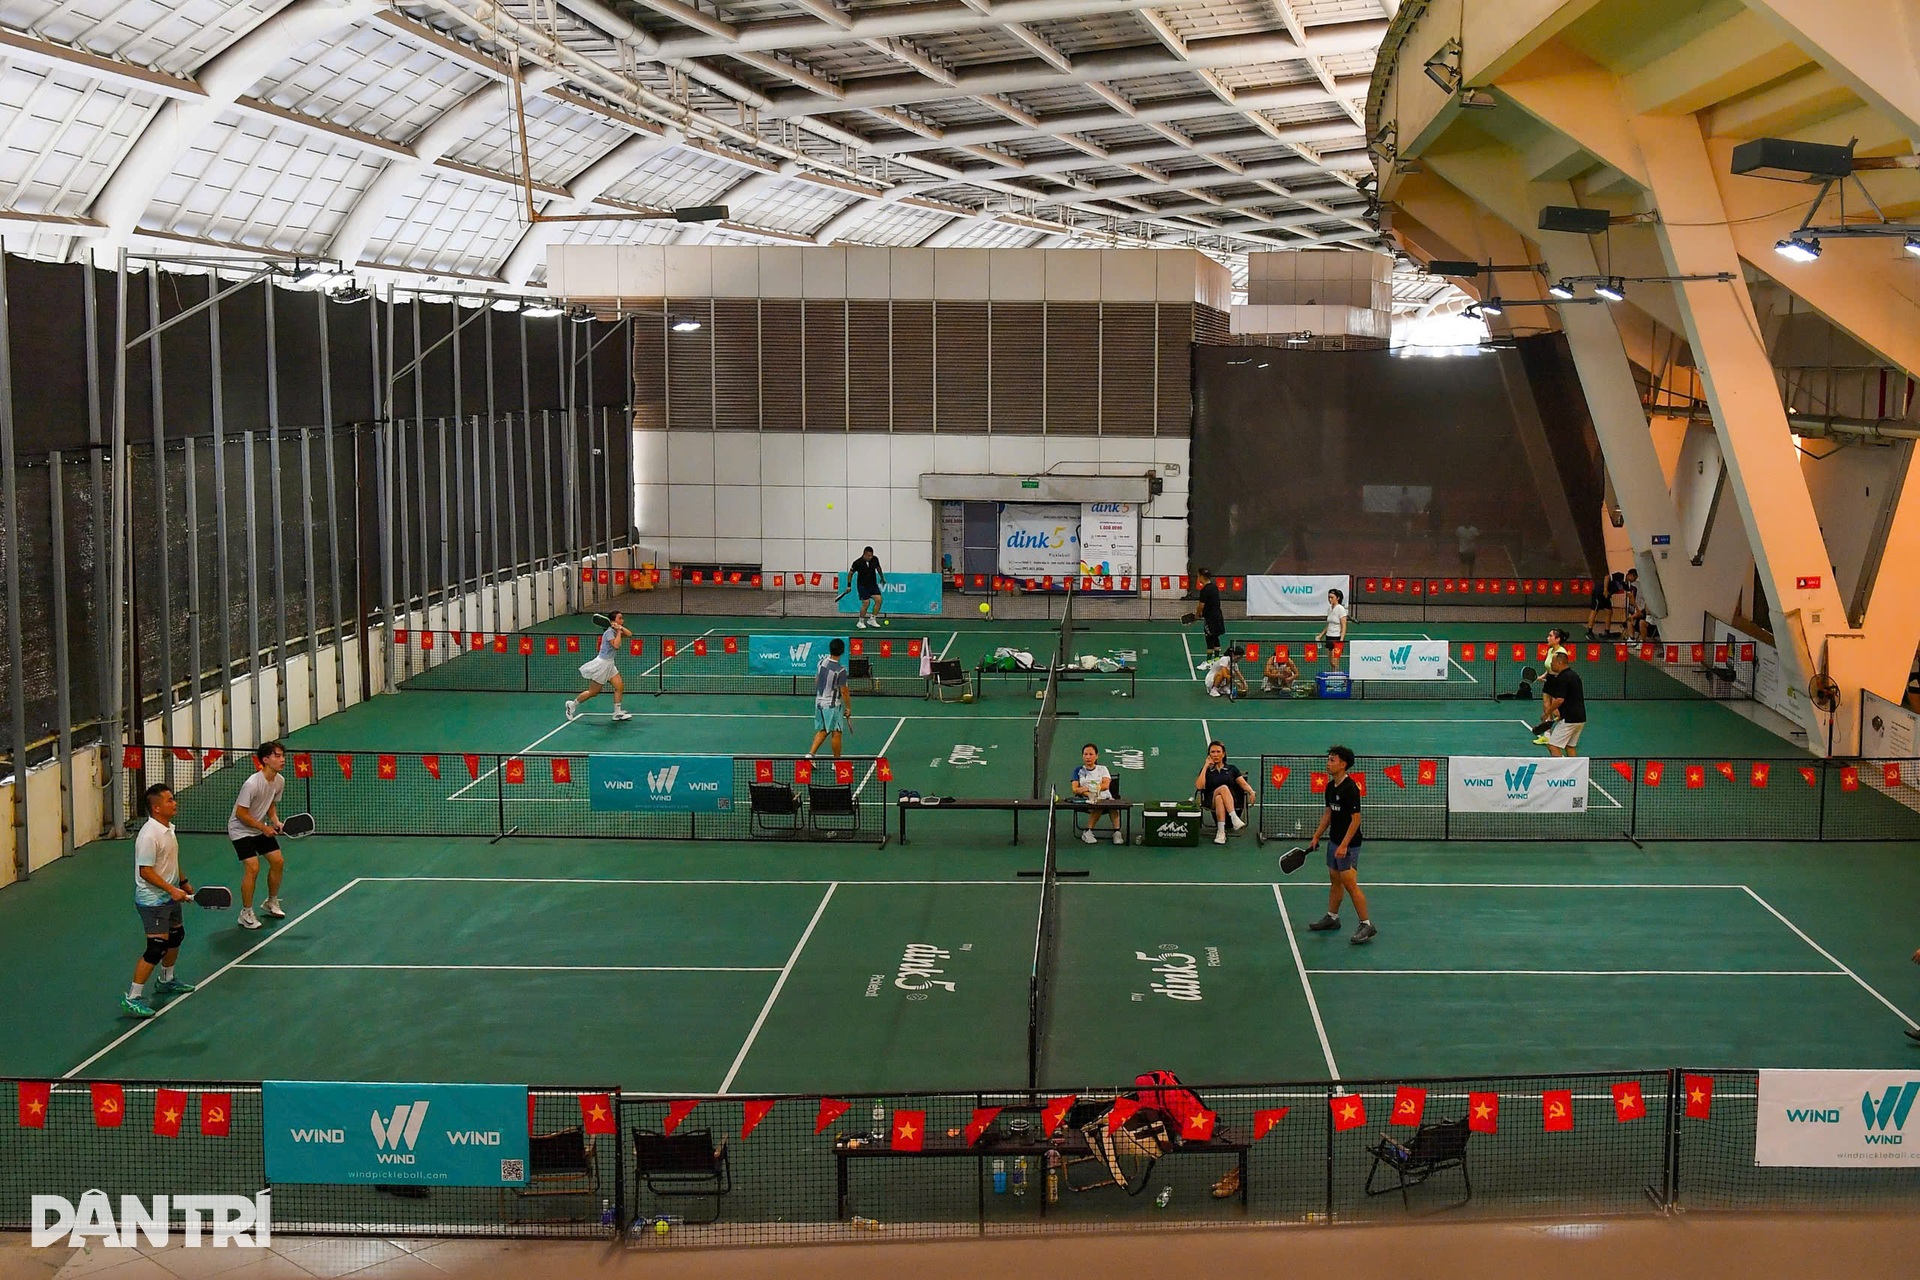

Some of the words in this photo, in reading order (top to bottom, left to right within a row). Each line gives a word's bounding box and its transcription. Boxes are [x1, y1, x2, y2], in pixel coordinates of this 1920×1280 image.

[1282, 586, 1313, 594] WIND
[604, 780, 633, 789] WIND
[688, 782, 718, 791] WIND
[1464, 779, 1494, 787] WIND
[1547, 779, 1576, 788] WIND
[1787, 1109, 1840, 1123] WIND
[291, 1128, 345, 1143] WIND
[447, 1130, 500, 1145] WIND
[1865, 1135, 1902, 1145] WIND
[377, 1154, 415, 1164] WIND
[348, 1171, 448, 1180] windpickleball.com
